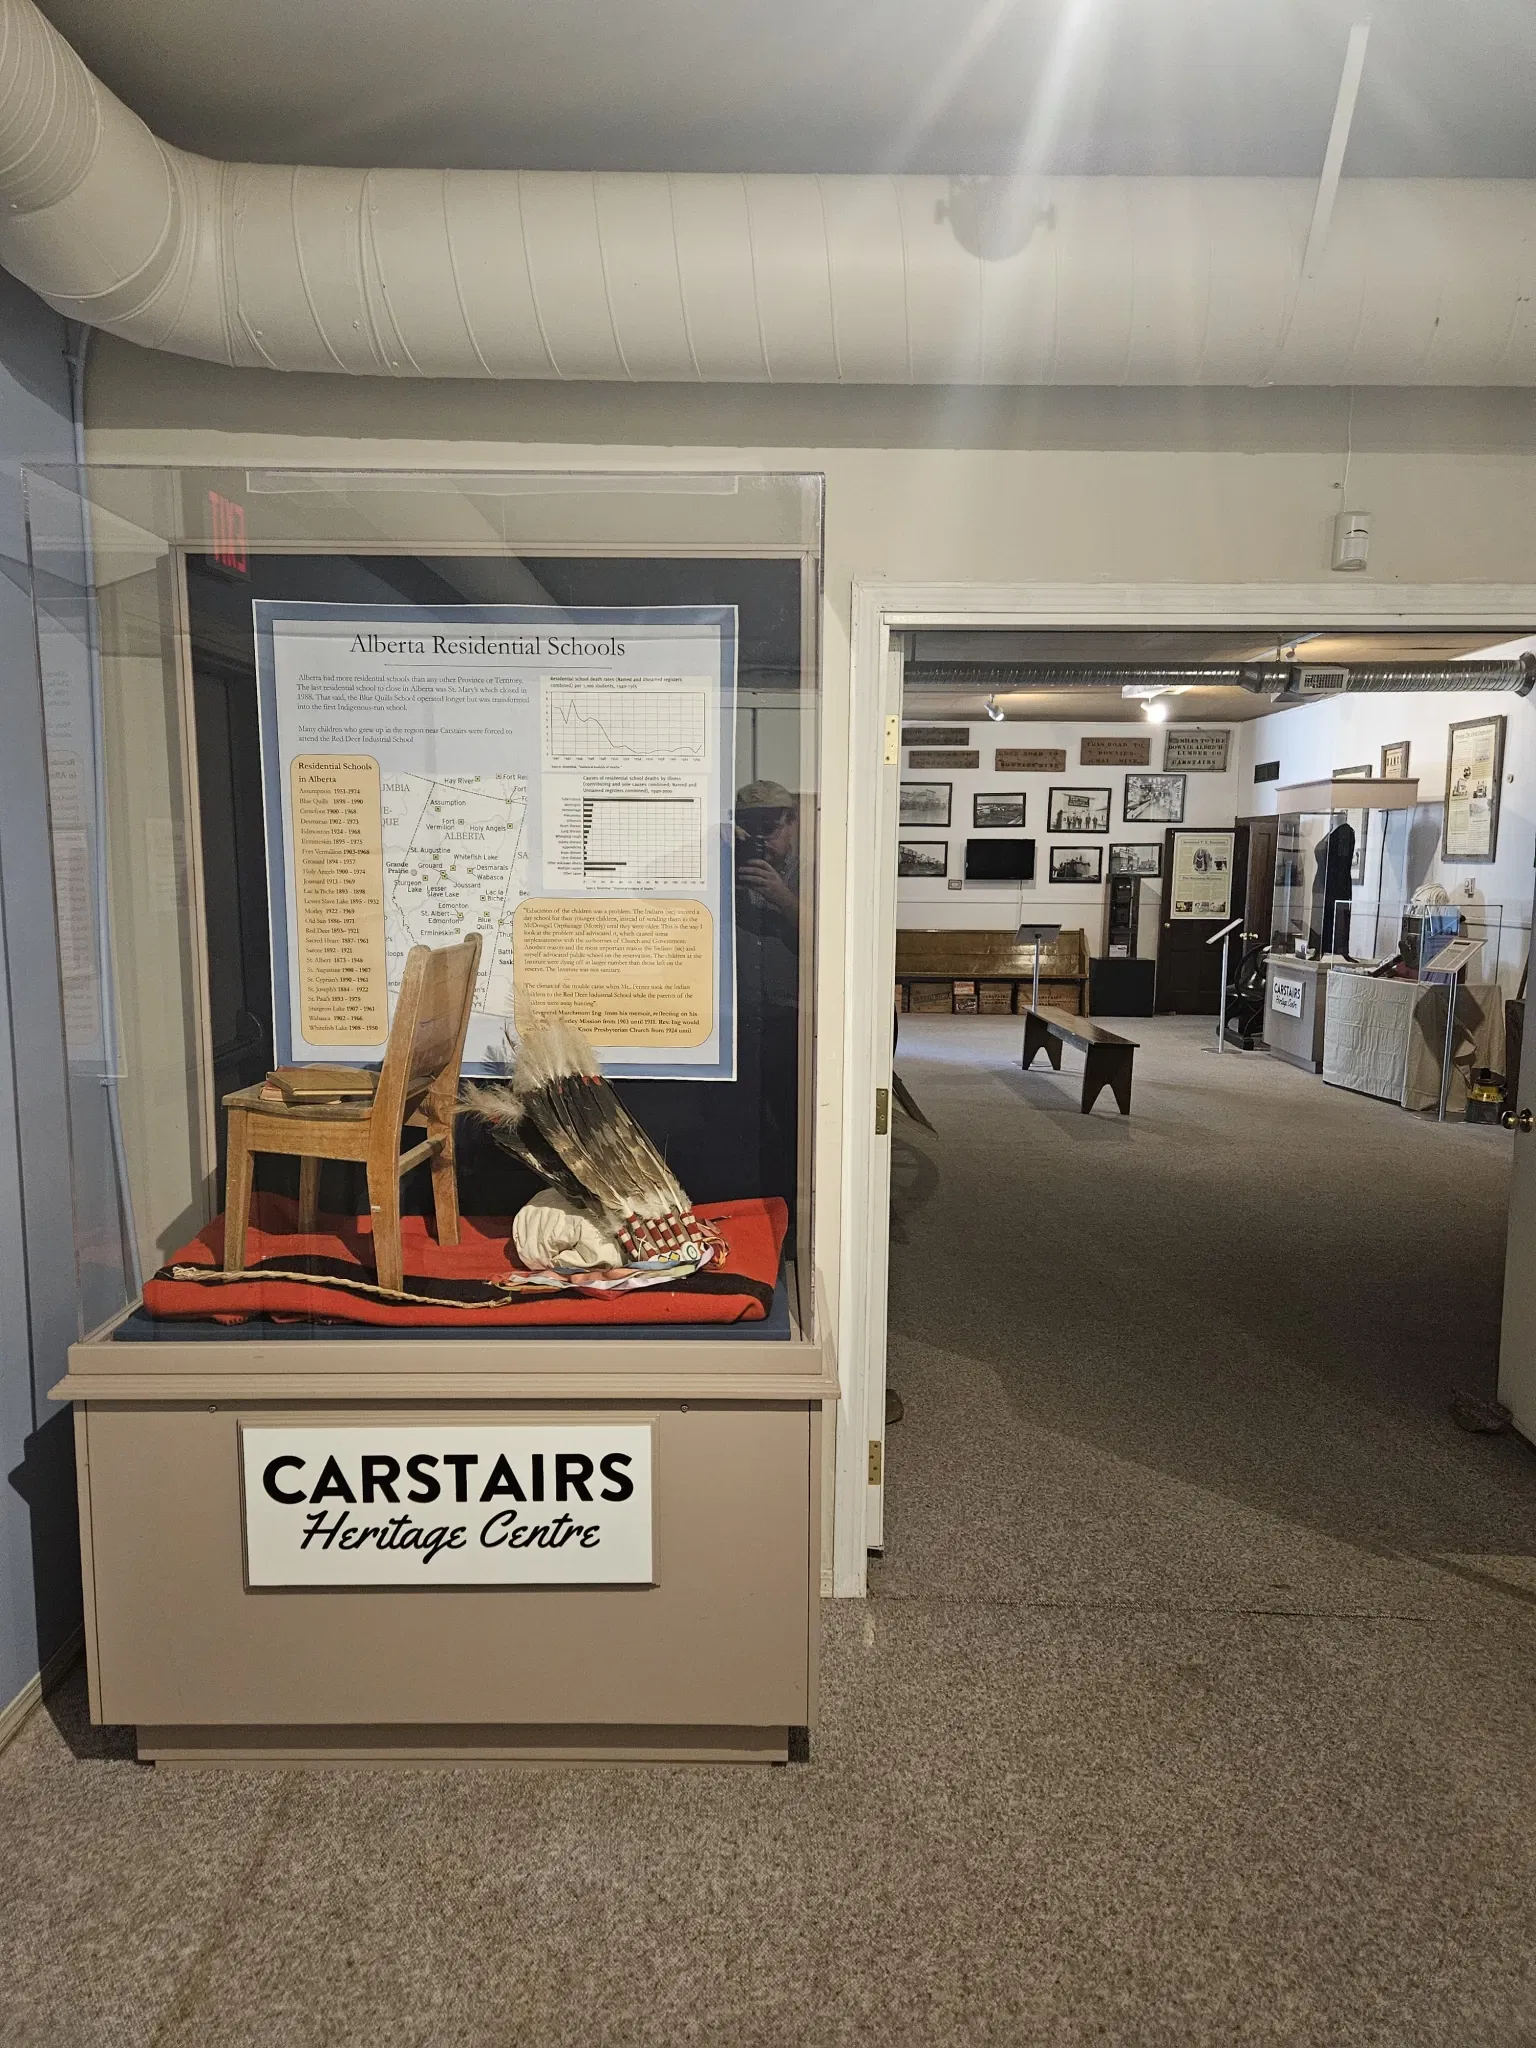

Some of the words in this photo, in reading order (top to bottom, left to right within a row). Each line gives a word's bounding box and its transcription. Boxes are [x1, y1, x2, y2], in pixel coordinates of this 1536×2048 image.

[350, 634, 426, 654] Alberta
[431, 635, 543, 655] Residential
[547, 636, 624, 656] Schools
[495, 677, 522, 686] Territory.
[458, 686, 478, 694] Mary's
[375, 695, 392, 703] Quills
[417, 695, 444, 704] operated
[445, 696, 465, 704] longer
[338, 704, 384, 712] Indigenous-run
[299, 726, 316, 735] Many
[404, 728, 424, 736] region
[1274, 983, 1300, 999] CARSTAIRS
[262, 1452, 634, 1504] CARSTAIRS
[300, 1510, 467, 1564] Heritage
[479, 1509, 600, 1549] Centre
